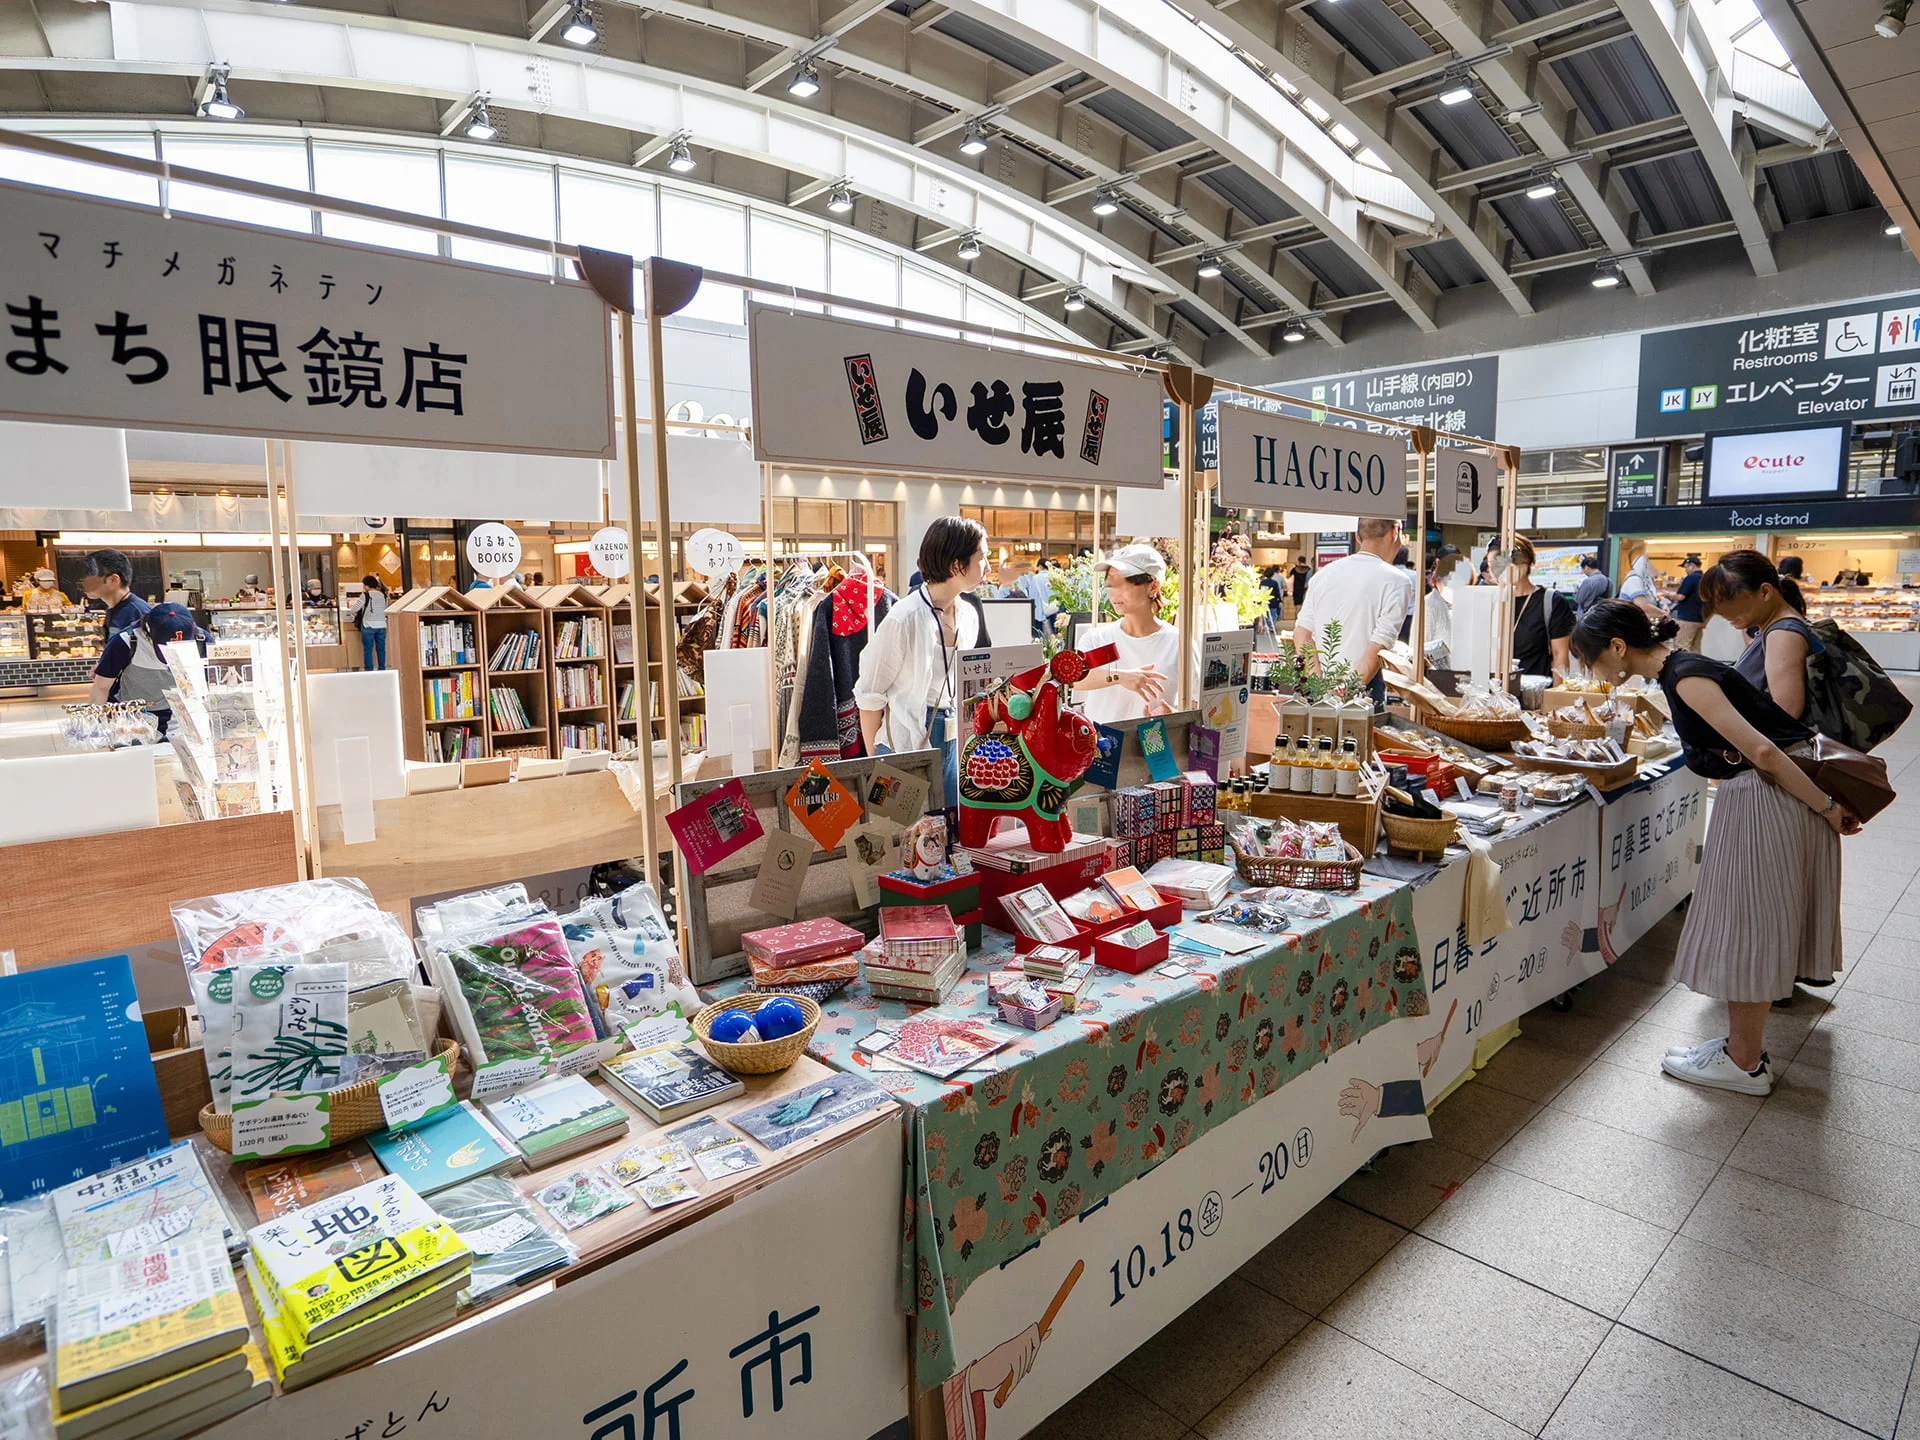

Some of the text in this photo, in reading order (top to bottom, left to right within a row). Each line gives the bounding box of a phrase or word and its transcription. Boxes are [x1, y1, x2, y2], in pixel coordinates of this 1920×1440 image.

[38, 231, 384, 306] マチメガネテン
[1738, 322, 1820, 354] 化粧室
[4, 294, 469, 416] まち眼鏡店
[1733, 351, 1818, 371] Restrooms
[1331, 380, 1356, 408] 11
[1366, 369, 1473, 400] 山手線（内回り）
[1664, 390, 1713, 408] JK JY
[1726, 372, 1870, 404] エレベーター
[849, 358, 885, 443] いせ辰
[905, 367, 1066, 460] いせ辰
[1366, 393, 1455, 413] Yamanote Line
[1797, 396, 1869, 416] Elevator
[1081, 392, 1107, 464] いせ辰
[1253, 433, 1386, 497] HAGISO
[1618, 465, 1630, 476] 11
[1744, 454, 1805, 469] ecute
[1729, 509, 1809, 527] food stand
[474, 535, 515, 548] ひるねこ
[604, 552, 624, 562] BOOK
[477, 551, 514, 564] BOOKS
[1206, 643, 1230, 653] HAGISO
[963, 661, 992, 675] いせ辰
[1611, 788, 1700, 873] 日暮里ご近所市
[1432, 856, 1588, 994] 日暮近所市
[77, 1154, 174, 1197] 中村市
[376, 1180, 401, 1226] 考えると
[260, 1225, 311, 1257] 楽しい
[307, 1204, 407, 1282] 地図
